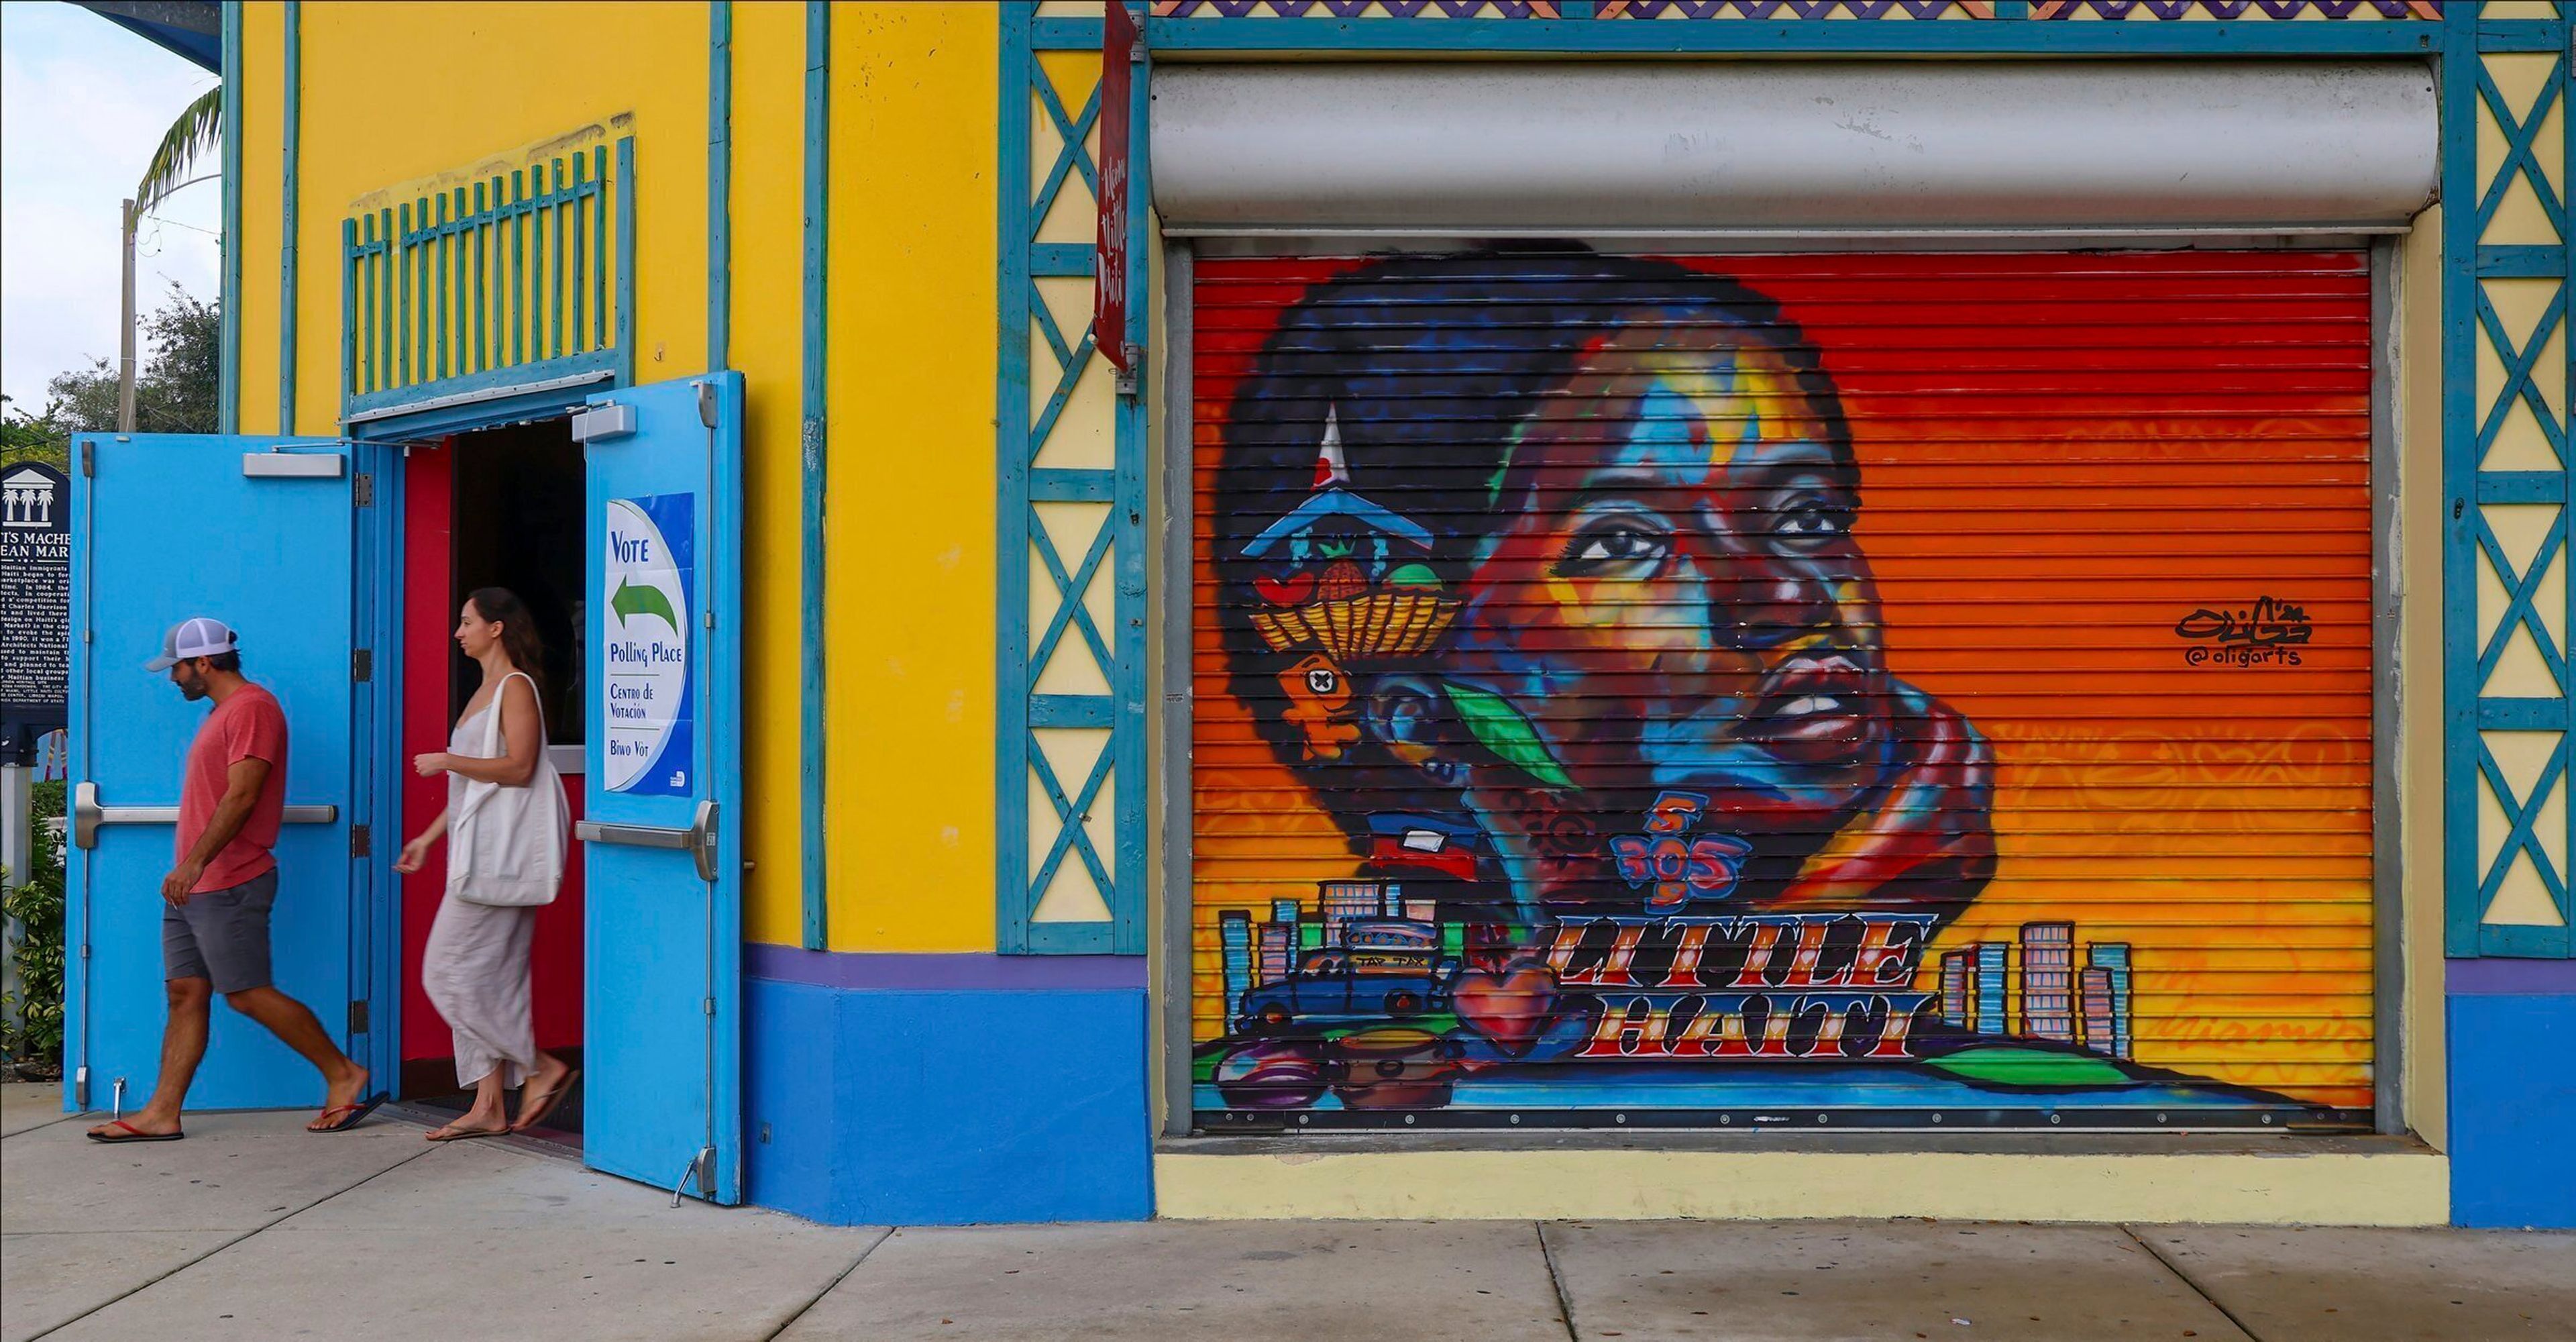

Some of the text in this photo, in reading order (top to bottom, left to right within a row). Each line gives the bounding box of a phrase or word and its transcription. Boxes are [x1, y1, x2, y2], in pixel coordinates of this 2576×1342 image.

[1, 545, 68, 557] EAN MAR
[24, 532, 71, 545] MACHE
[611, 531, 649, 563] VOTE
[2185, 646, 2302, 668] @oligarts
[1547, 913, 1939, 988] LITTLE
[1574, 992, 1940, 1058] HAITI
